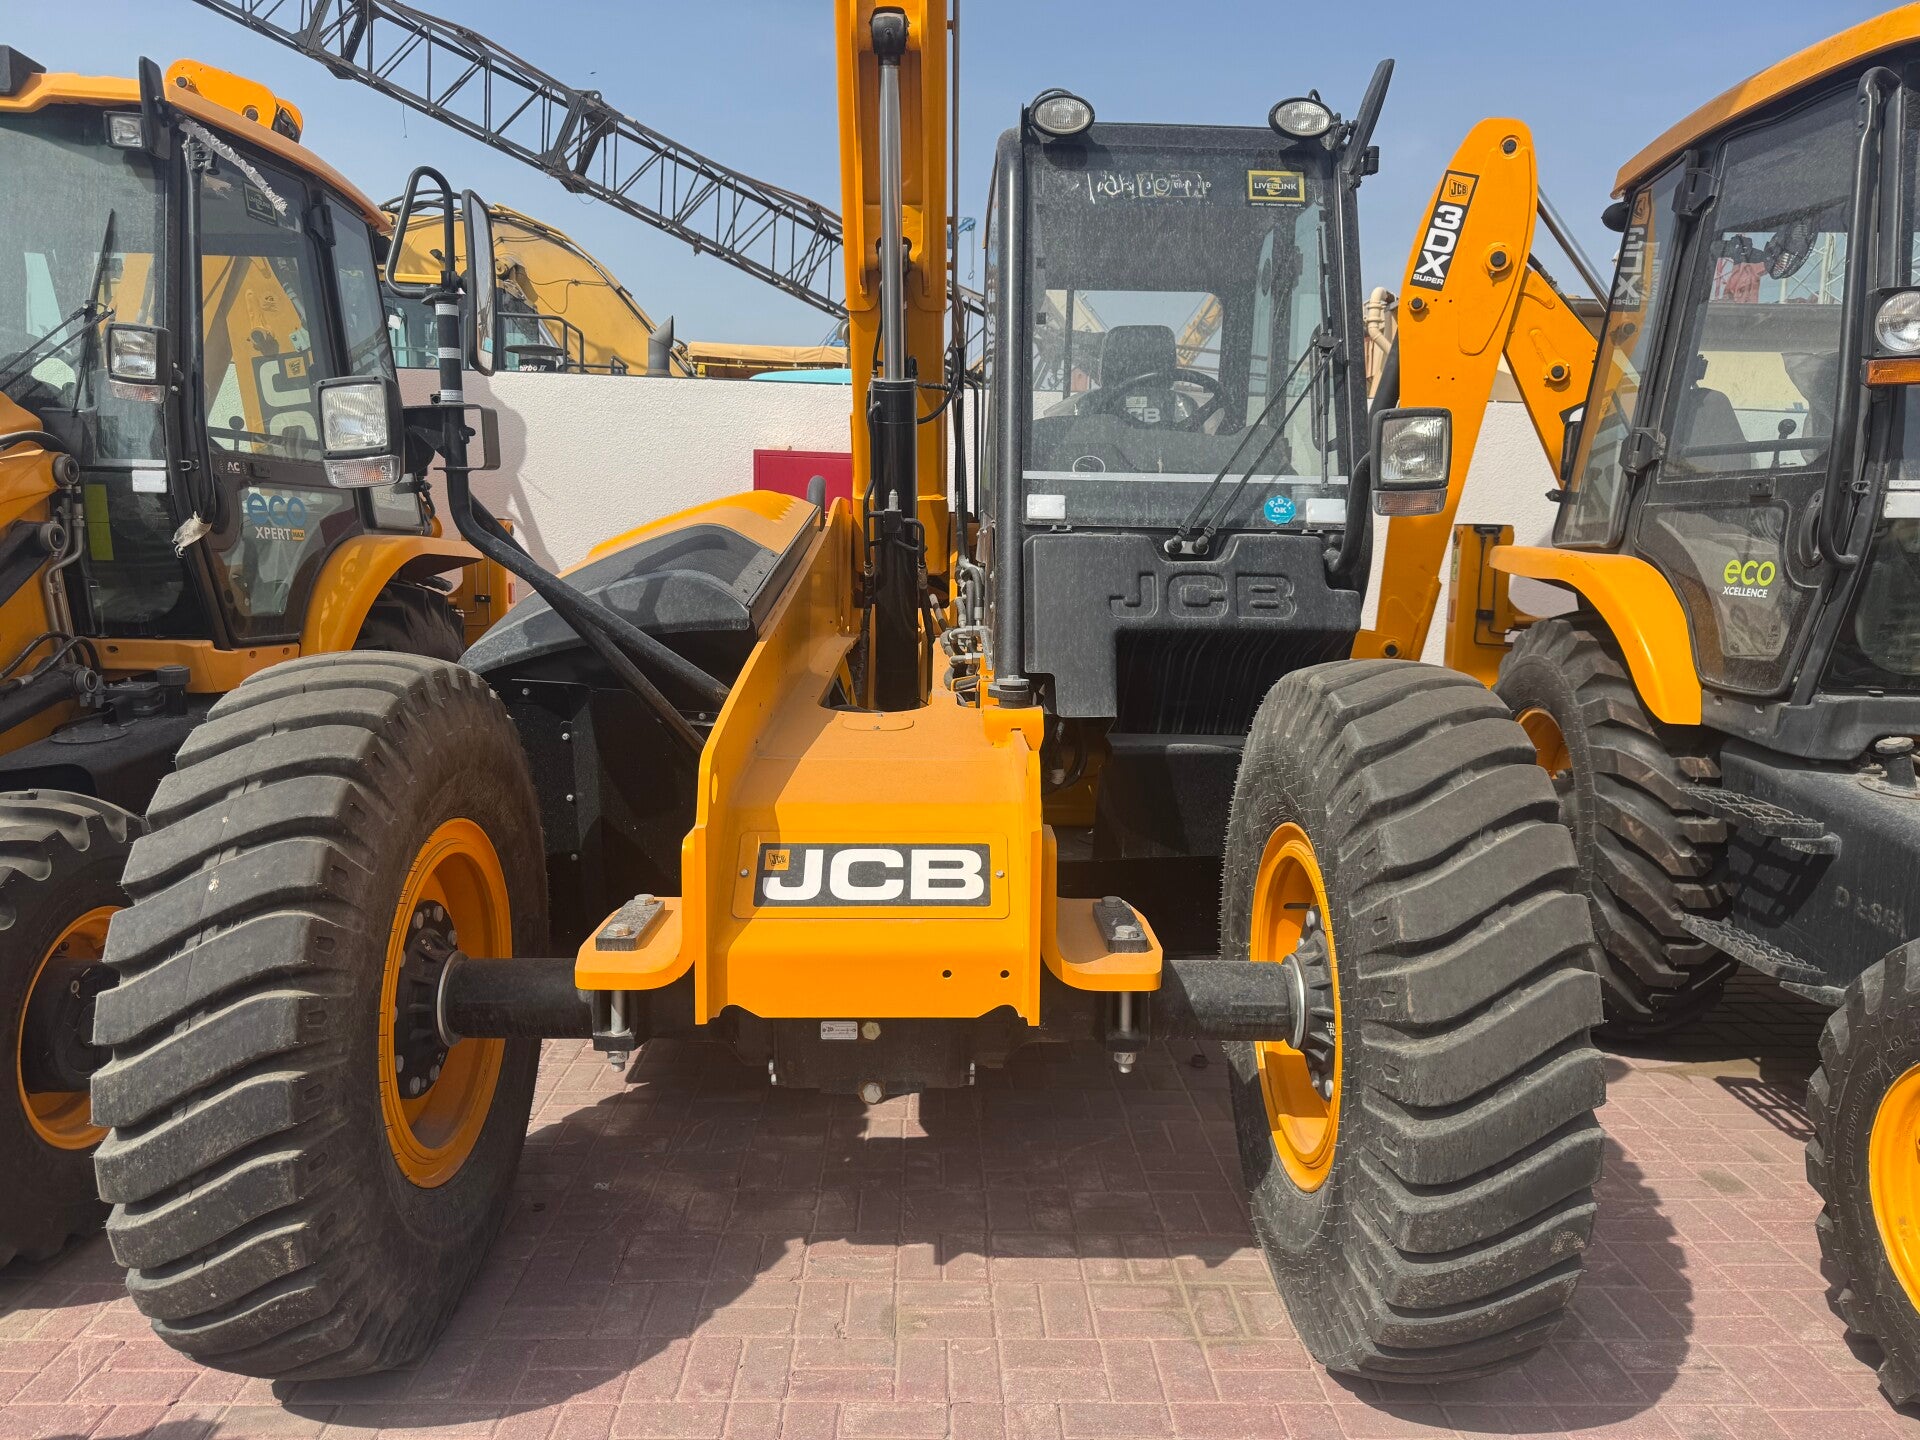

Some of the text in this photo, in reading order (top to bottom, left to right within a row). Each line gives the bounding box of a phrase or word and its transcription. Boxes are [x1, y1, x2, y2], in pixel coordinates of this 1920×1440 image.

[1450, 182, 1468, 196] JCB
[1415, 204, 1463, 278] 3DX
[1413, 273, 1445, 286] SUPER
[247, 492, 306, 527] eco
[254, 526, 290, 540] XPERT
[1723, 559, 1776, 587] eco
[1108, 571, 1298, 620] JCB
[1722, 586, 1768, 598] XCELLENCE
[762, 848, 985, 901] JCB
